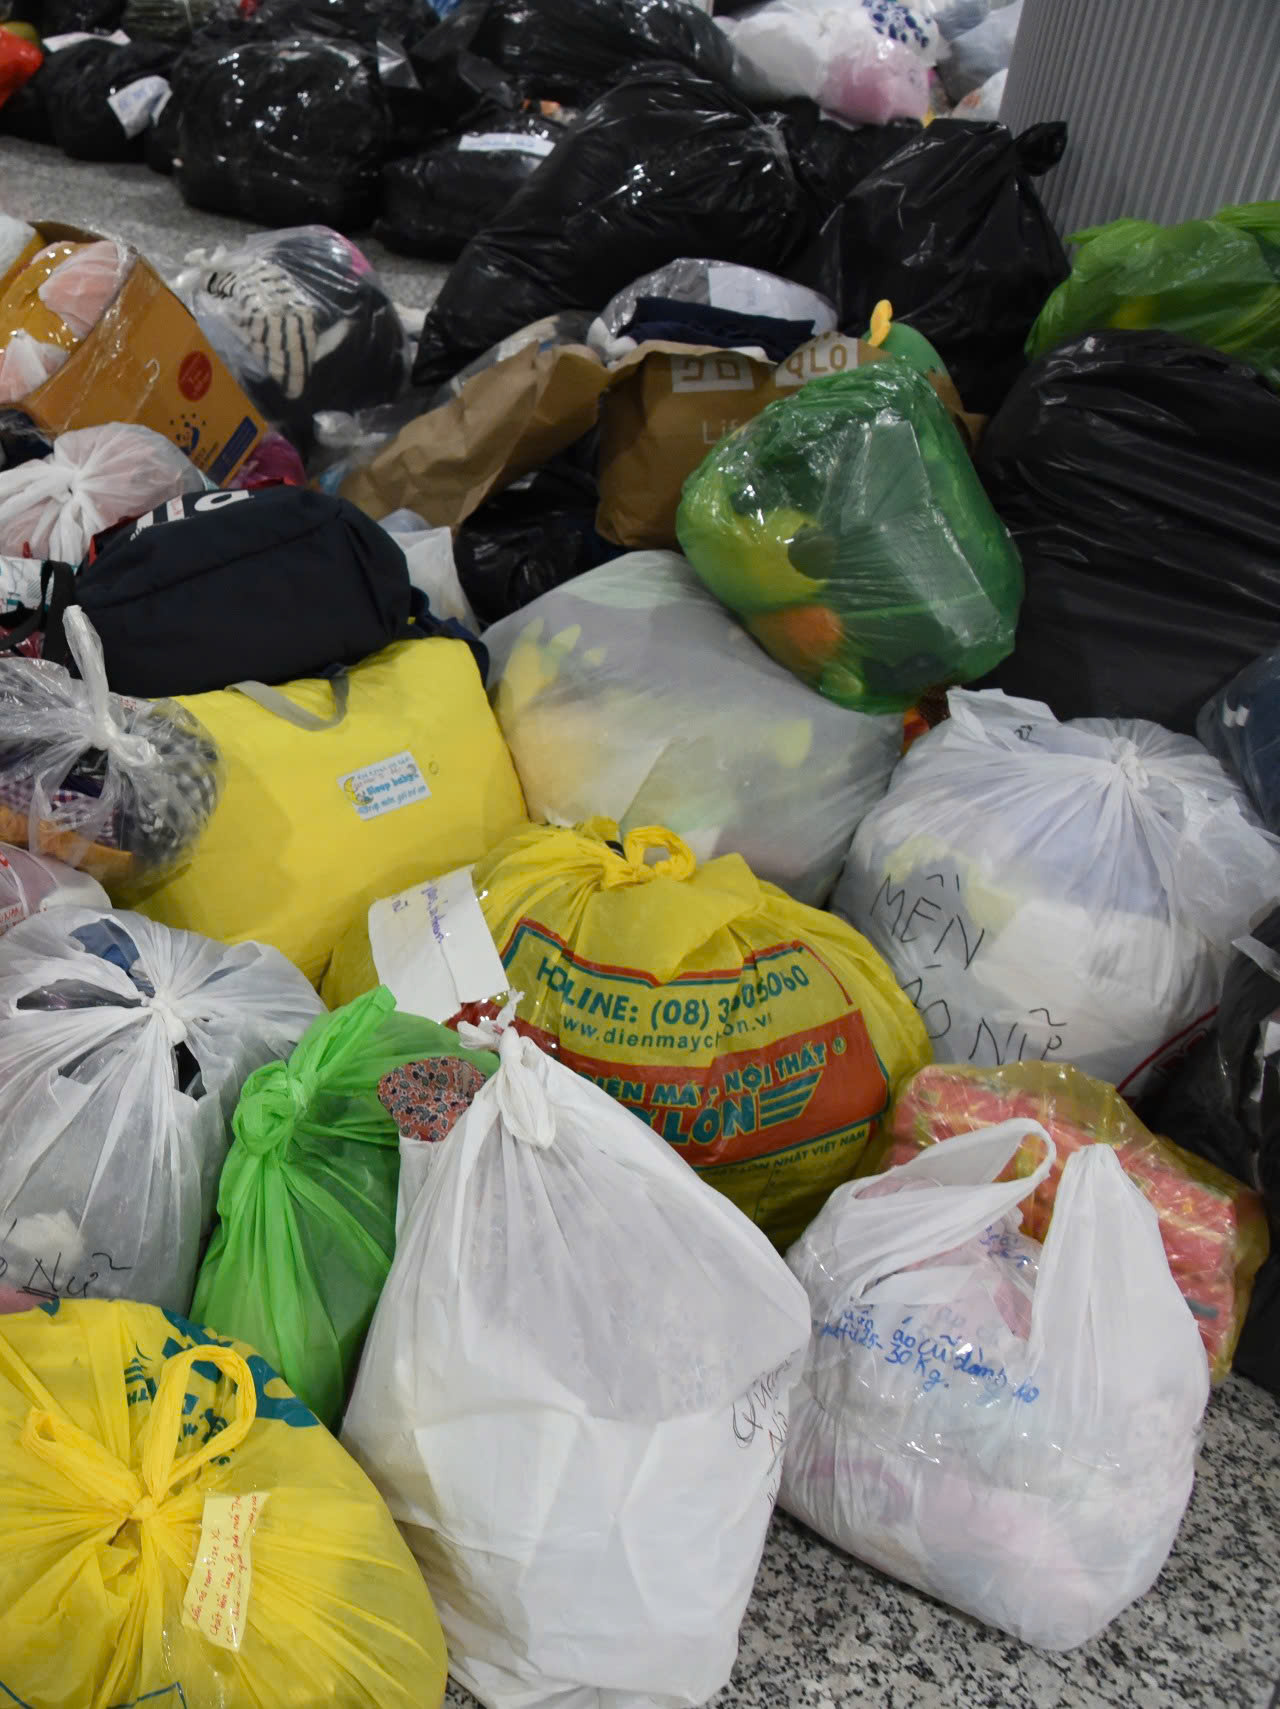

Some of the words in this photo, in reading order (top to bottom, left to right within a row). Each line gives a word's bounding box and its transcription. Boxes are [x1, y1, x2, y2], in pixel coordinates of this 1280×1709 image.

[786, 343, 848, 379] QLO
[536, 956, 638, 1024] HOLINE:
[651, 998, 710, 1031] (08)
[776, 1040, 826, 1079] THẤT
